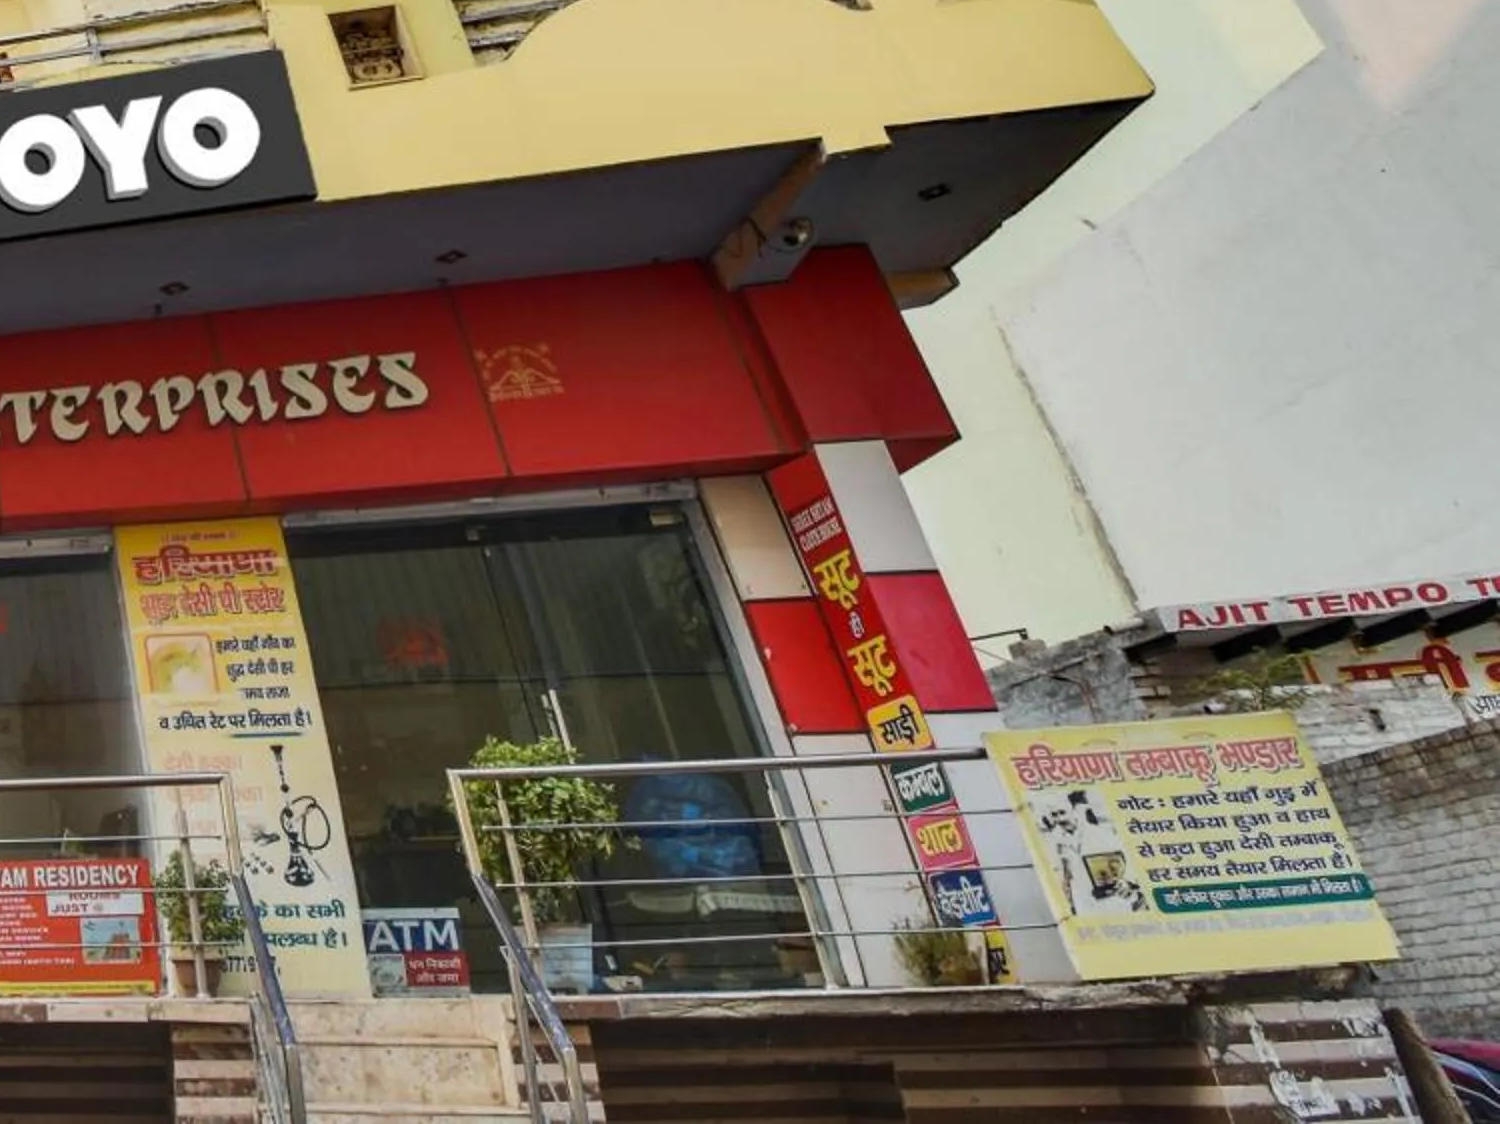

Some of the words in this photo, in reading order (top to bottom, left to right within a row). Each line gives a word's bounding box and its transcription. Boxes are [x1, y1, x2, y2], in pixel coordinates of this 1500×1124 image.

[812, 549, 860, 611] सूट
[1176, 601, 1272, 631] AJIT
[1287, 582, 1450, 618] TEMPO
[847, 634, 897, 697] सूट
[208, 708, 227, 729] रेट
[228, 714, 247, 728] पर
[248, 707, 291, 728] मिलता
[1010, 742, 1122, 791] हरियाणा
[1121, 744, 1221, 788] तम्बाकू
[1215, 736, 1305, 775] भण्डार
[1169, 787, 1219, 809] हमारे
[1301, 777, 1320, 798] में
[916, 818, 963, 857] शाल
[1126, 815, 1176, 835] तैयार
[1178, 812, 1227, 831] किया
[1231, 812, 1270, 833] हुआ
[1275, 809, 1291, 824] व
[1137, 839, 1156, 859] से
[1199, 838, 1236, 860] हुआ
[34, 863, 140, 888] RESIDENCY
[1146, 867, 1172, 884] हर
[1176, 863, 1222, 881] समय
[1225, 858, 1269, 876] तैयार
[1269, 854, 1327, 873] मिलता
[51, 902, 89, 914] JUST
[275, 904, 300, 918] का
[307, 898, 346, 918] सभी
[369, 919, 460, 951] ATM
